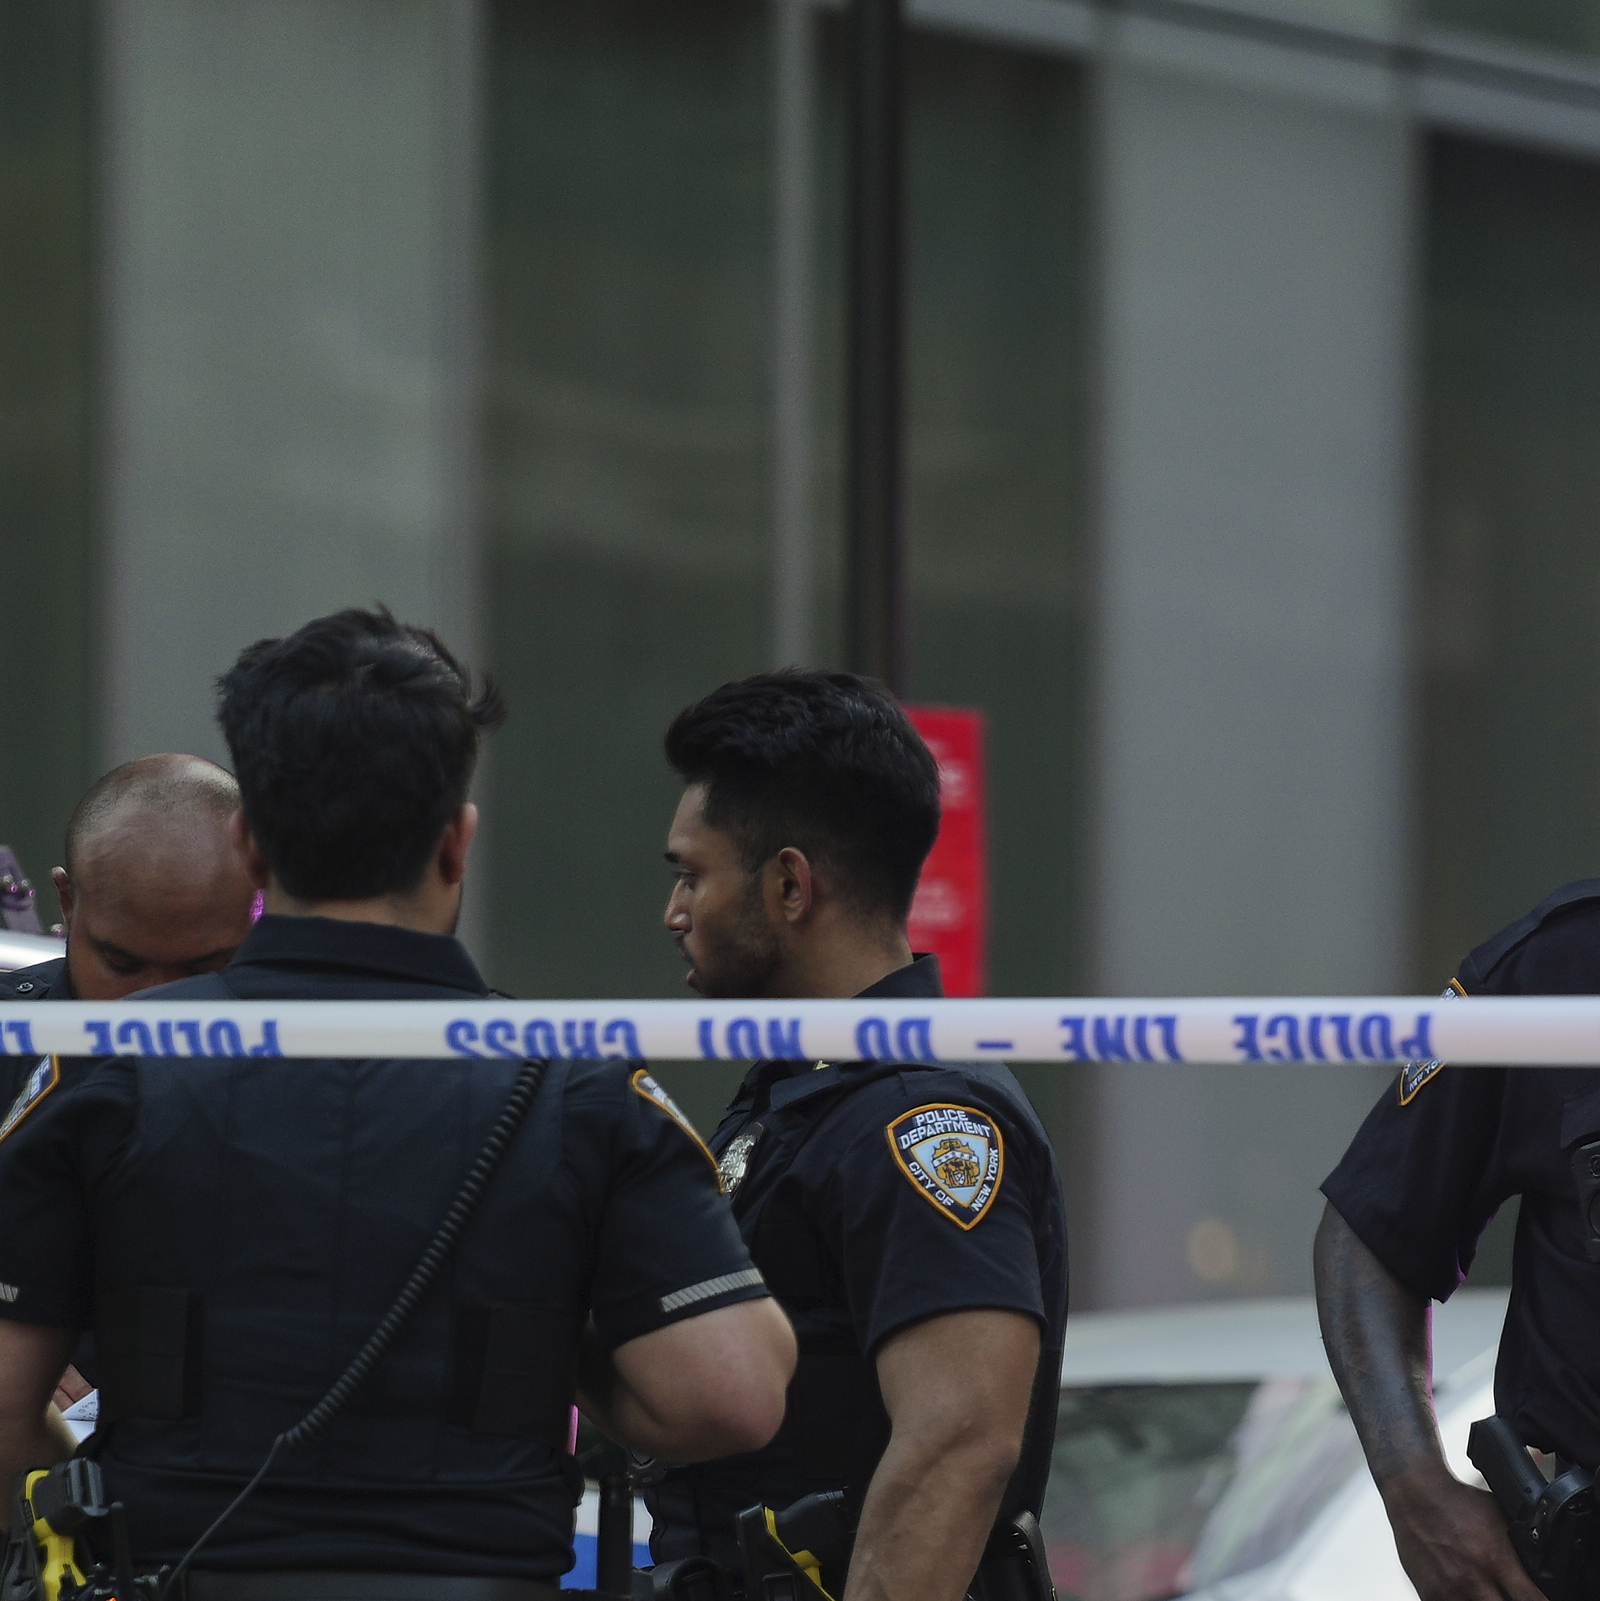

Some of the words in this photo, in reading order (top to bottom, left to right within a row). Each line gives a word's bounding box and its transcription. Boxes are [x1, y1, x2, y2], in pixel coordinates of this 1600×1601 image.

[84, 1019, 284, 1058] POLICE
[444, 1017, 646, 1060] CROSS
[698, 1017, 806, 1061] NOT
[854, 1016, 937, 1061] DO
[1059, 1014, 1185, 1062] LINE
[1233, 1013, 1439, 1062] POLICE
[900, 1121, 990, 1150] DEPARTMENT
[915, 1109, 968, 1126] POLICE
[908, 1161, 936, 1189] CITY
[935, 1189, 954, 1206] OF
[970, 1184, 992, 1212] NEW
[985, 1147, 998, 1181] YORK
